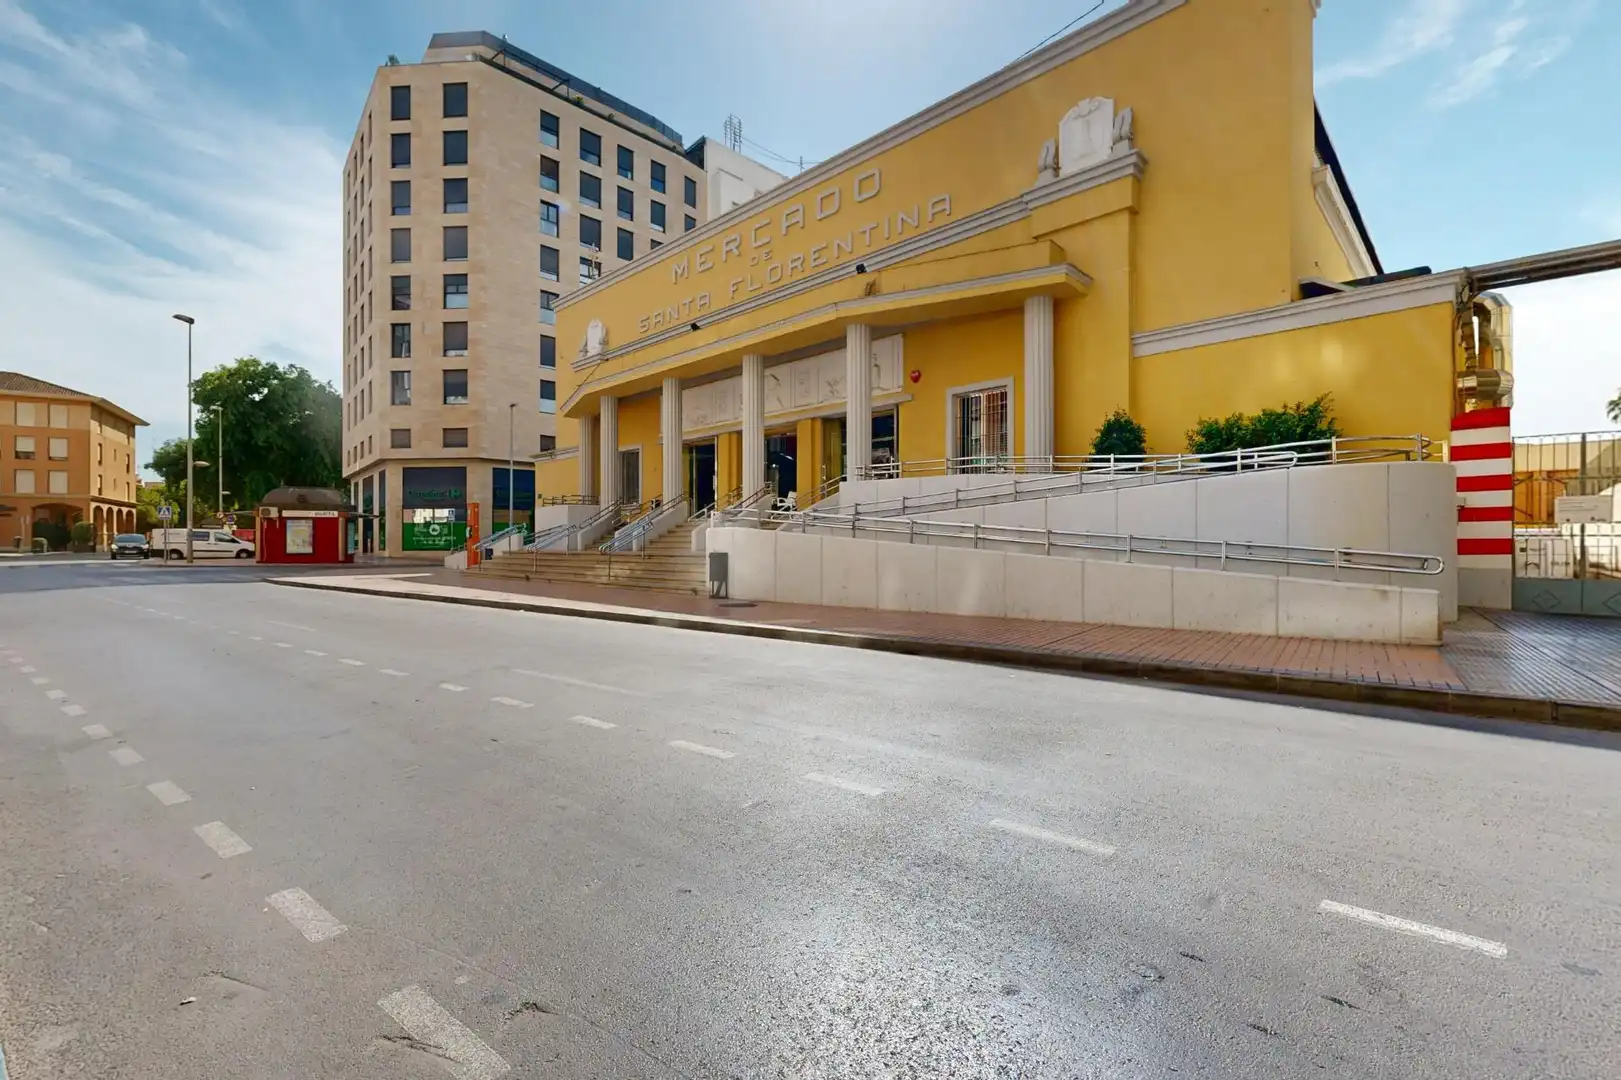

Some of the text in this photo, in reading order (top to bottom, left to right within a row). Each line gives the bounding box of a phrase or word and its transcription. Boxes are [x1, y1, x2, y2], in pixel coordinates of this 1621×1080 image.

[639, 194, 952, 334] SANTA FLORENTINA
[672, 168, 882, 284] MERCADO
[749, 248, 773, 268] DE
